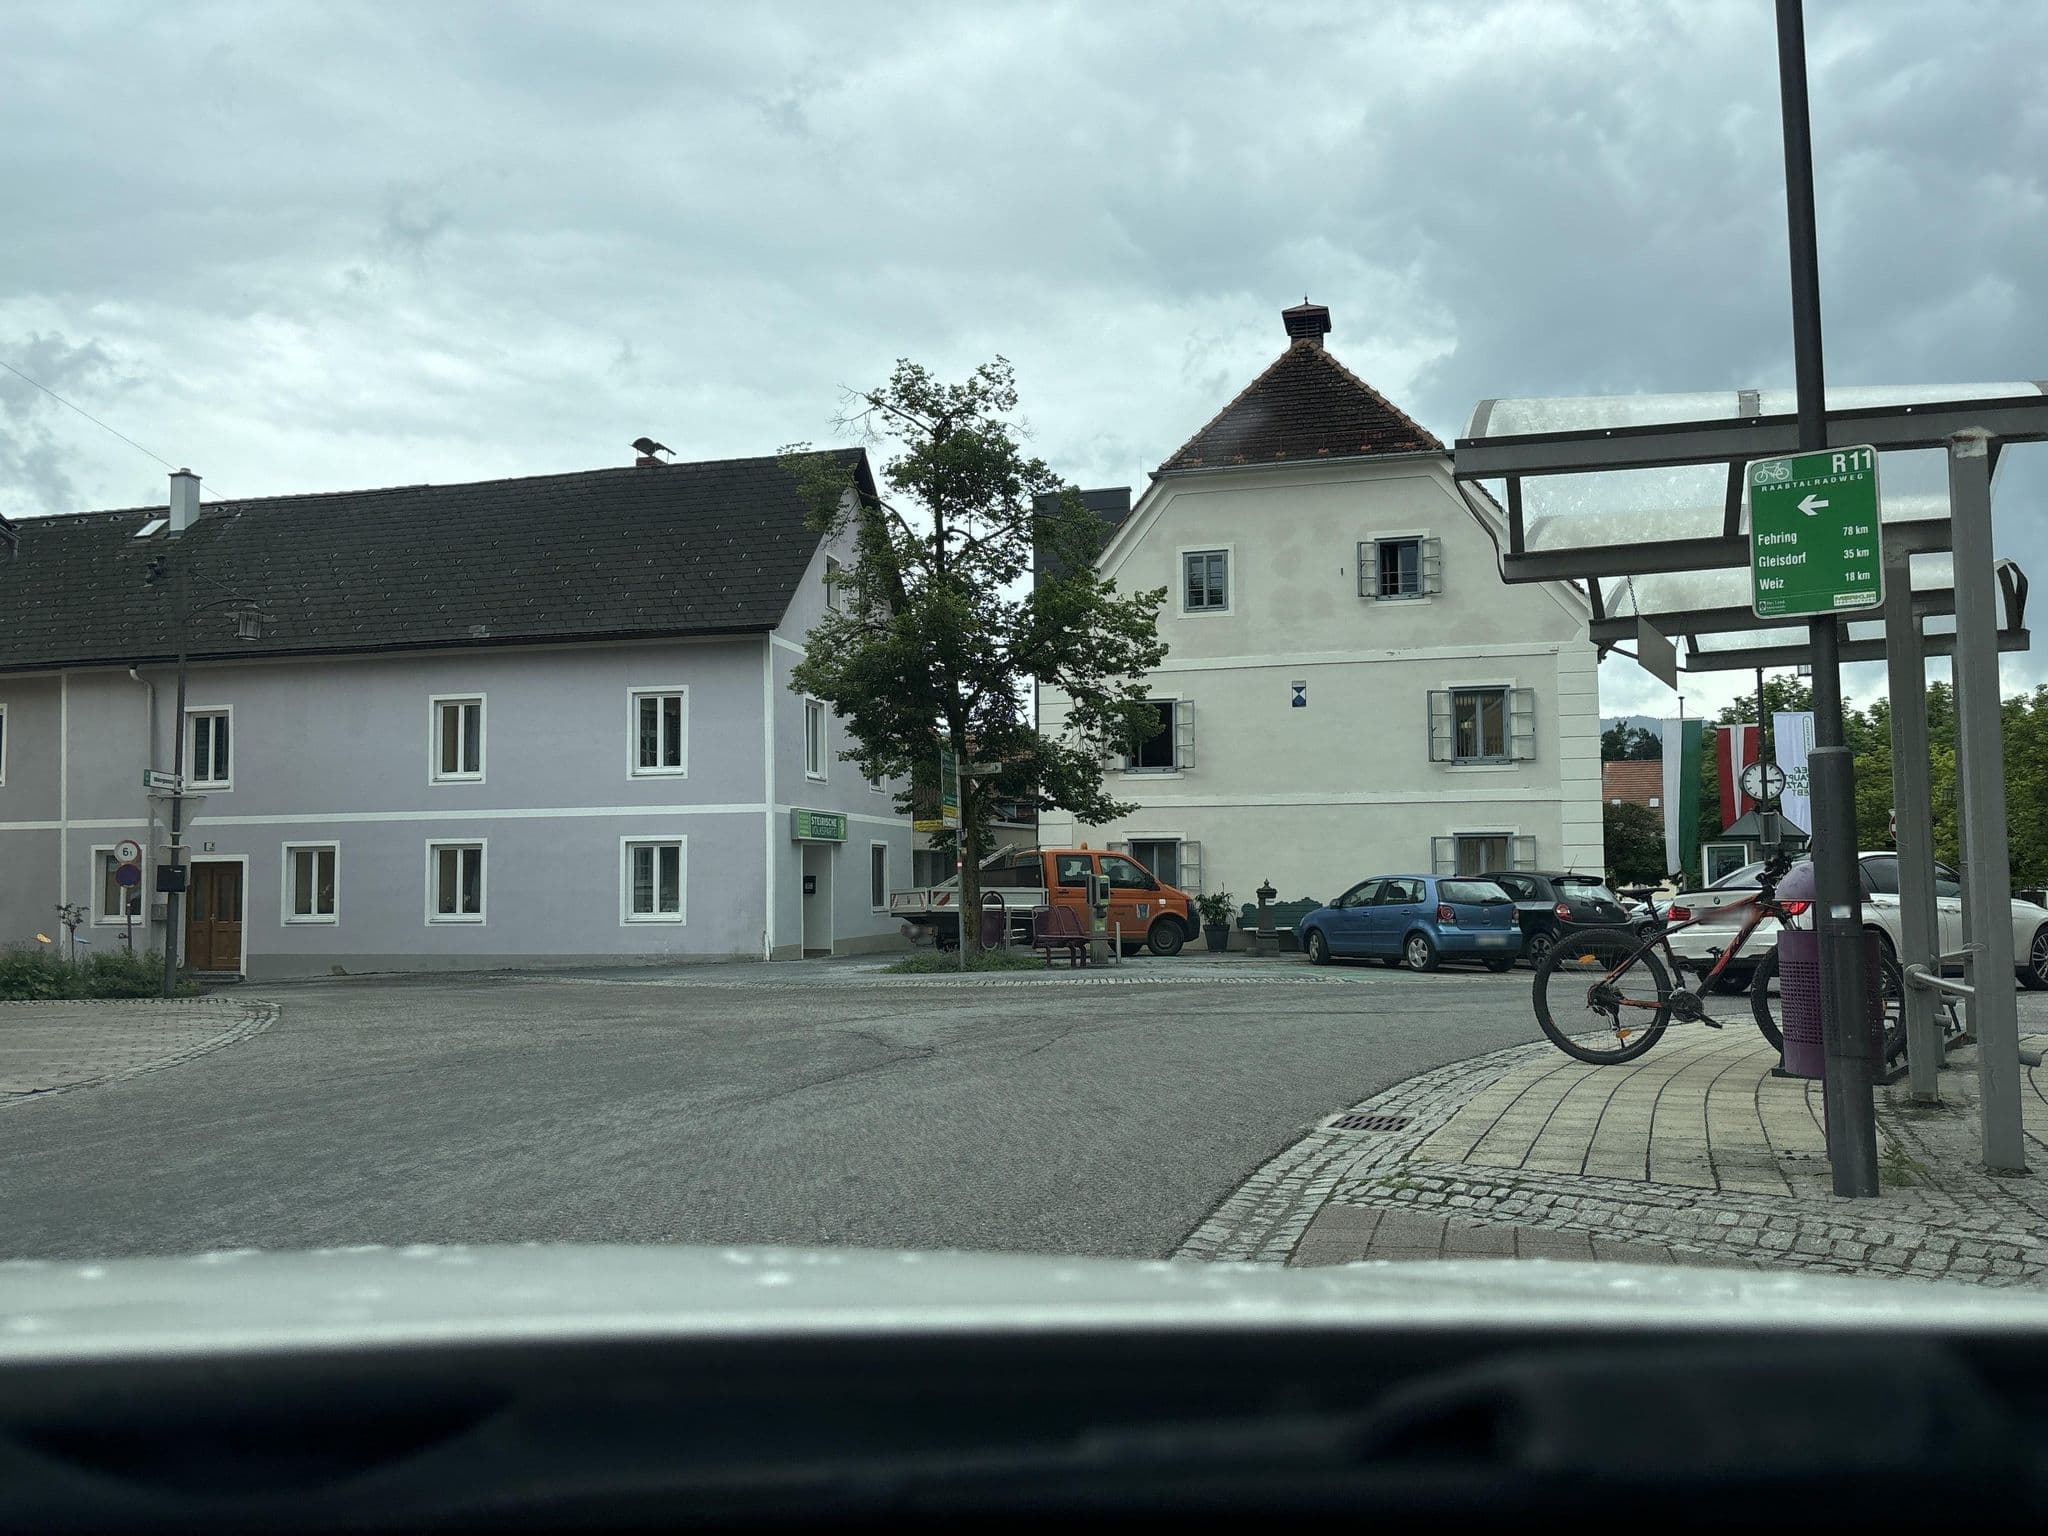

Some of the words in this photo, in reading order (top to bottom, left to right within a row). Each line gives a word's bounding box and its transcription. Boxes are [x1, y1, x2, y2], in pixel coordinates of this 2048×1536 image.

[1832, 450, 1871, 473] R11
[1762, 473, 1864, 492] RAABTALRADWEG
[1758, 531, 1798, 546] Fehring
[1843, 526, 1854, 536] 78
[1856, 525, 1869, 534] km
[1759, 552, 1807, 568] Gleisdorf
[1843, 549, 1855, 559] 35
[1856, 548, 1870, 558] km
[1760, 577, 1785, 590] Weiz
[1845, 571, 1856, 582] 18
[1857, 571, 1871, 580] km
